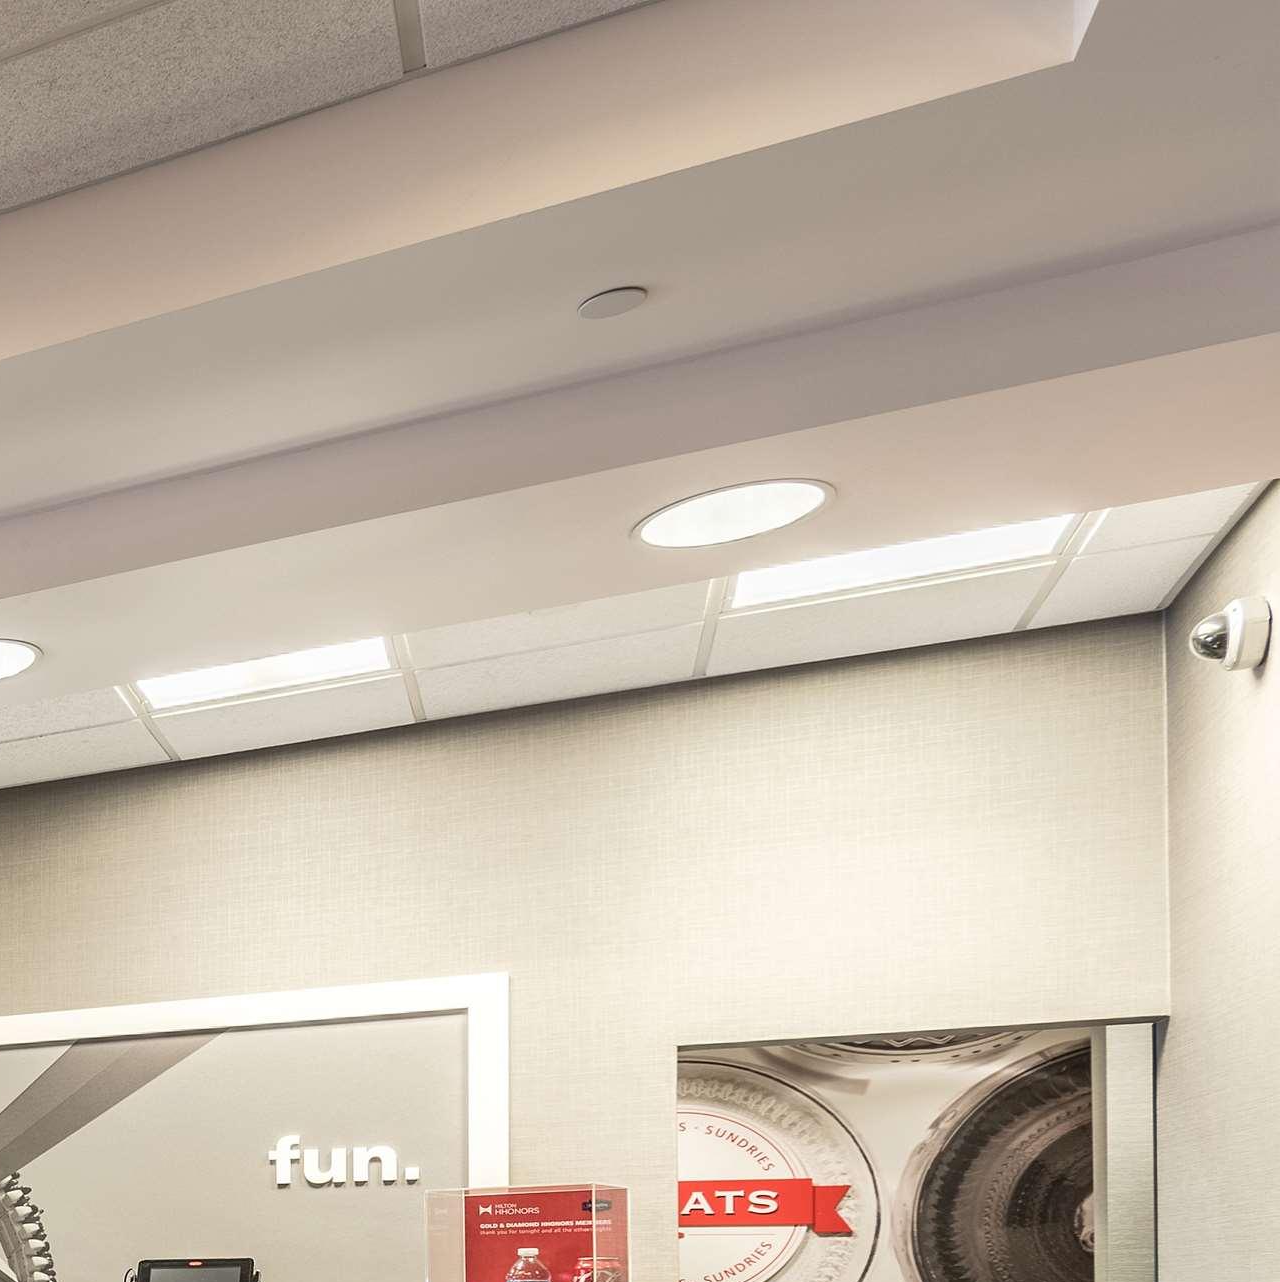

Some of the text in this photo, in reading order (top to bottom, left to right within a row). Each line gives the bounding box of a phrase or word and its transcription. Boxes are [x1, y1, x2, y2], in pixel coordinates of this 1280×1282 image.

[268, 1134, 420, 1186] fun.
[705, 1125, 775, 1172] SUNDRIES
[495, 1206, 540, 1215] HHONORS
